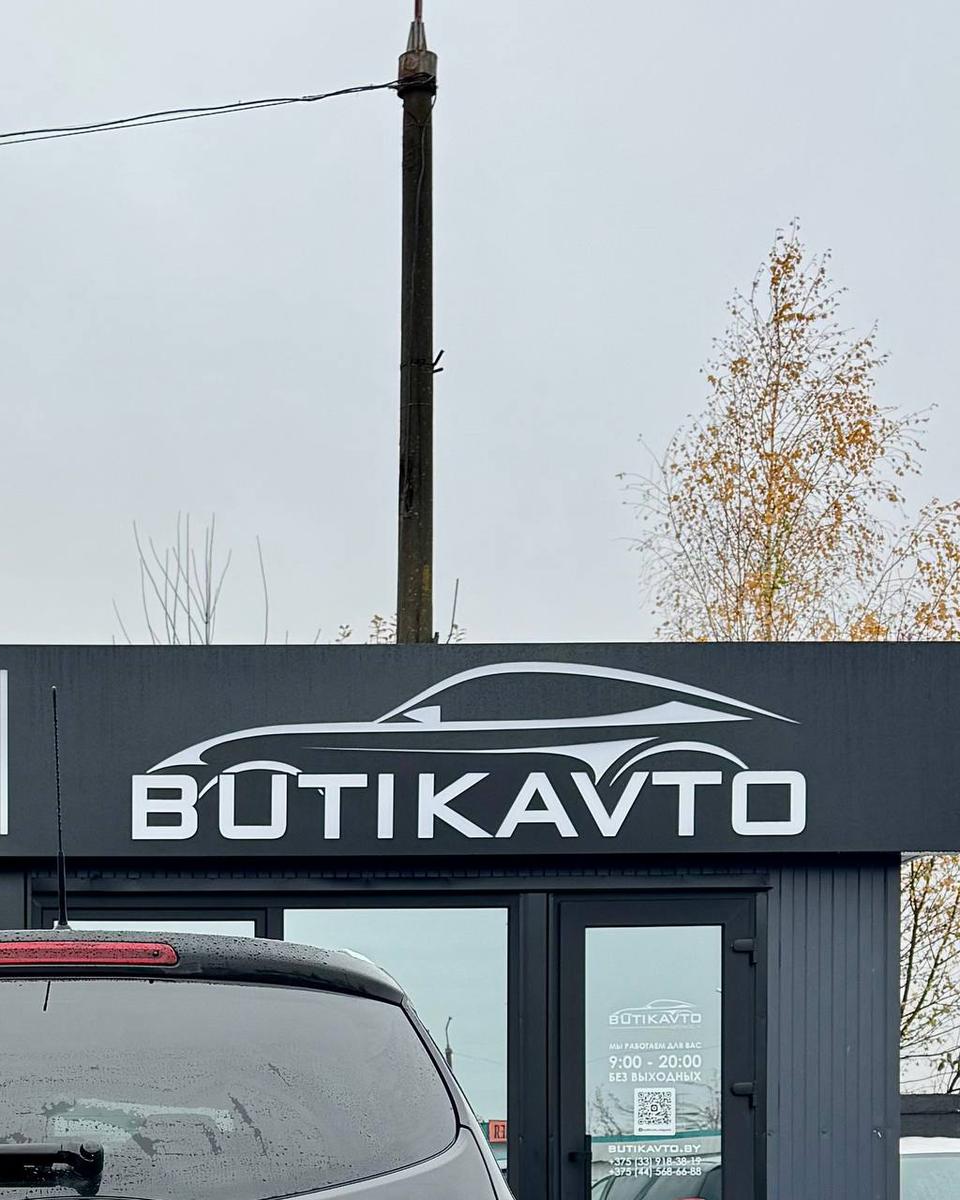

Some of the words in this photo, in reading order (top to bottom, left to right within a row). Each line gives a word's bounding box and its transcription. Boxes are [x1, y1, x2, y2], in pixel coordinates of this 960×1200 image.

[130, 769, 808, 840] BUTIKAVTO
[609, 1013, 702, 1025] BUTIKAVTO
[685, 1041, 702, 1049] ВАС
[609, 1055, 642, 1069] 9:00
[658, 1055, 702, 1068] 20:00
[609, 1072, 628, 1082] БЕЗ
[631, 1072, 702, 1083] ВЫХОДНЫХ
[608, 1145, 701, 1153] BUTIKAVTO.BY
[609, 1157, 632, 1166] +375
[634, 1157, 652, 1168] (33)
[655, 1157, 702, 1166] 918-38-19
[609, 1167, 632, 1176] +375
[634, 1167, 652, 1178] (44)
[655, 1167, 702, 1176] 568-66-88
